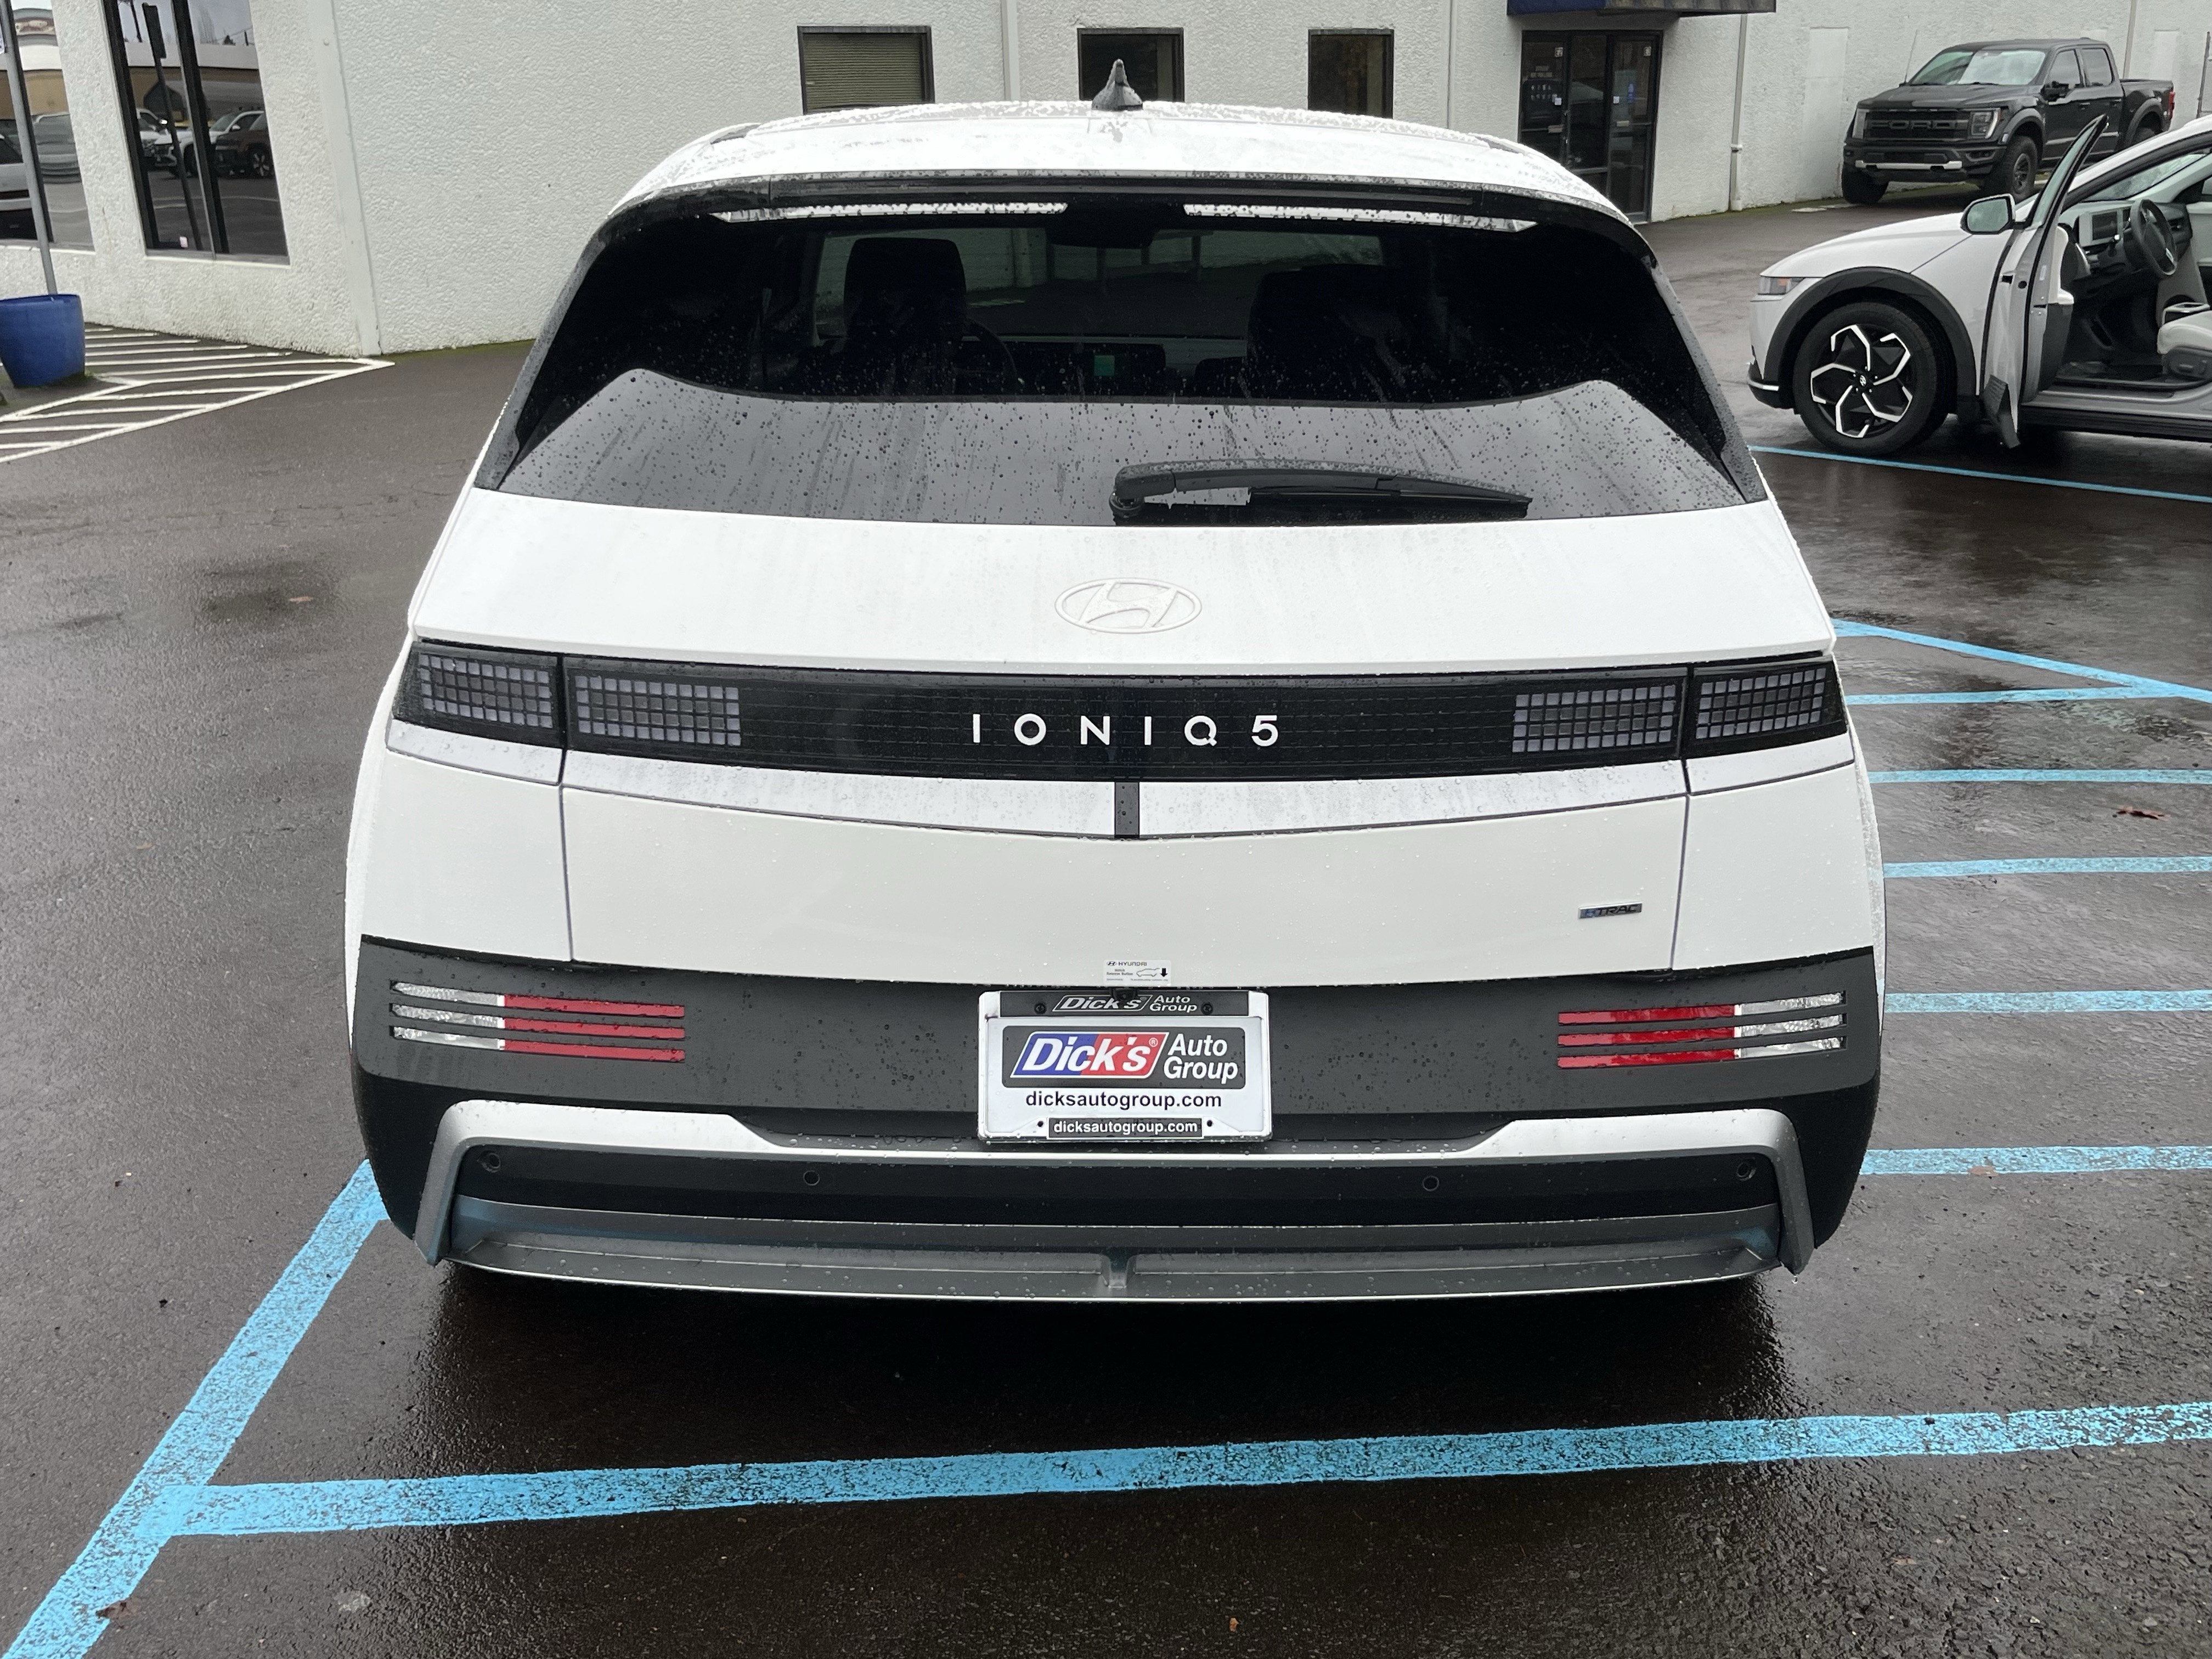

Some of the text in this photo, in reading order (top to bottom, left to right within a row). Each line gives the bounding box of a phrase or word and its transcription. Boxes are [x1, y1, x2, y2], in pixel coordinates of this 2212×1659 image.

[1869, 120, 1956, 130] FORD
[972, 713, 1279, 747] IONIQ 5
[1585, 905, 1639, 916] HTRAC
[1060, 995, 1190, 1009] Dicks Auto
[1149, 1003, 1198, 1013] Group
[1023, 1033, 1228, 1073] Dick's Auto
[1164, 1057, 1238, 1084] Group
[1026, 1091, 1222, 1110] dicksautogroup.com
[1053, 1120, 1198, 1135] dicksautogroup.com
